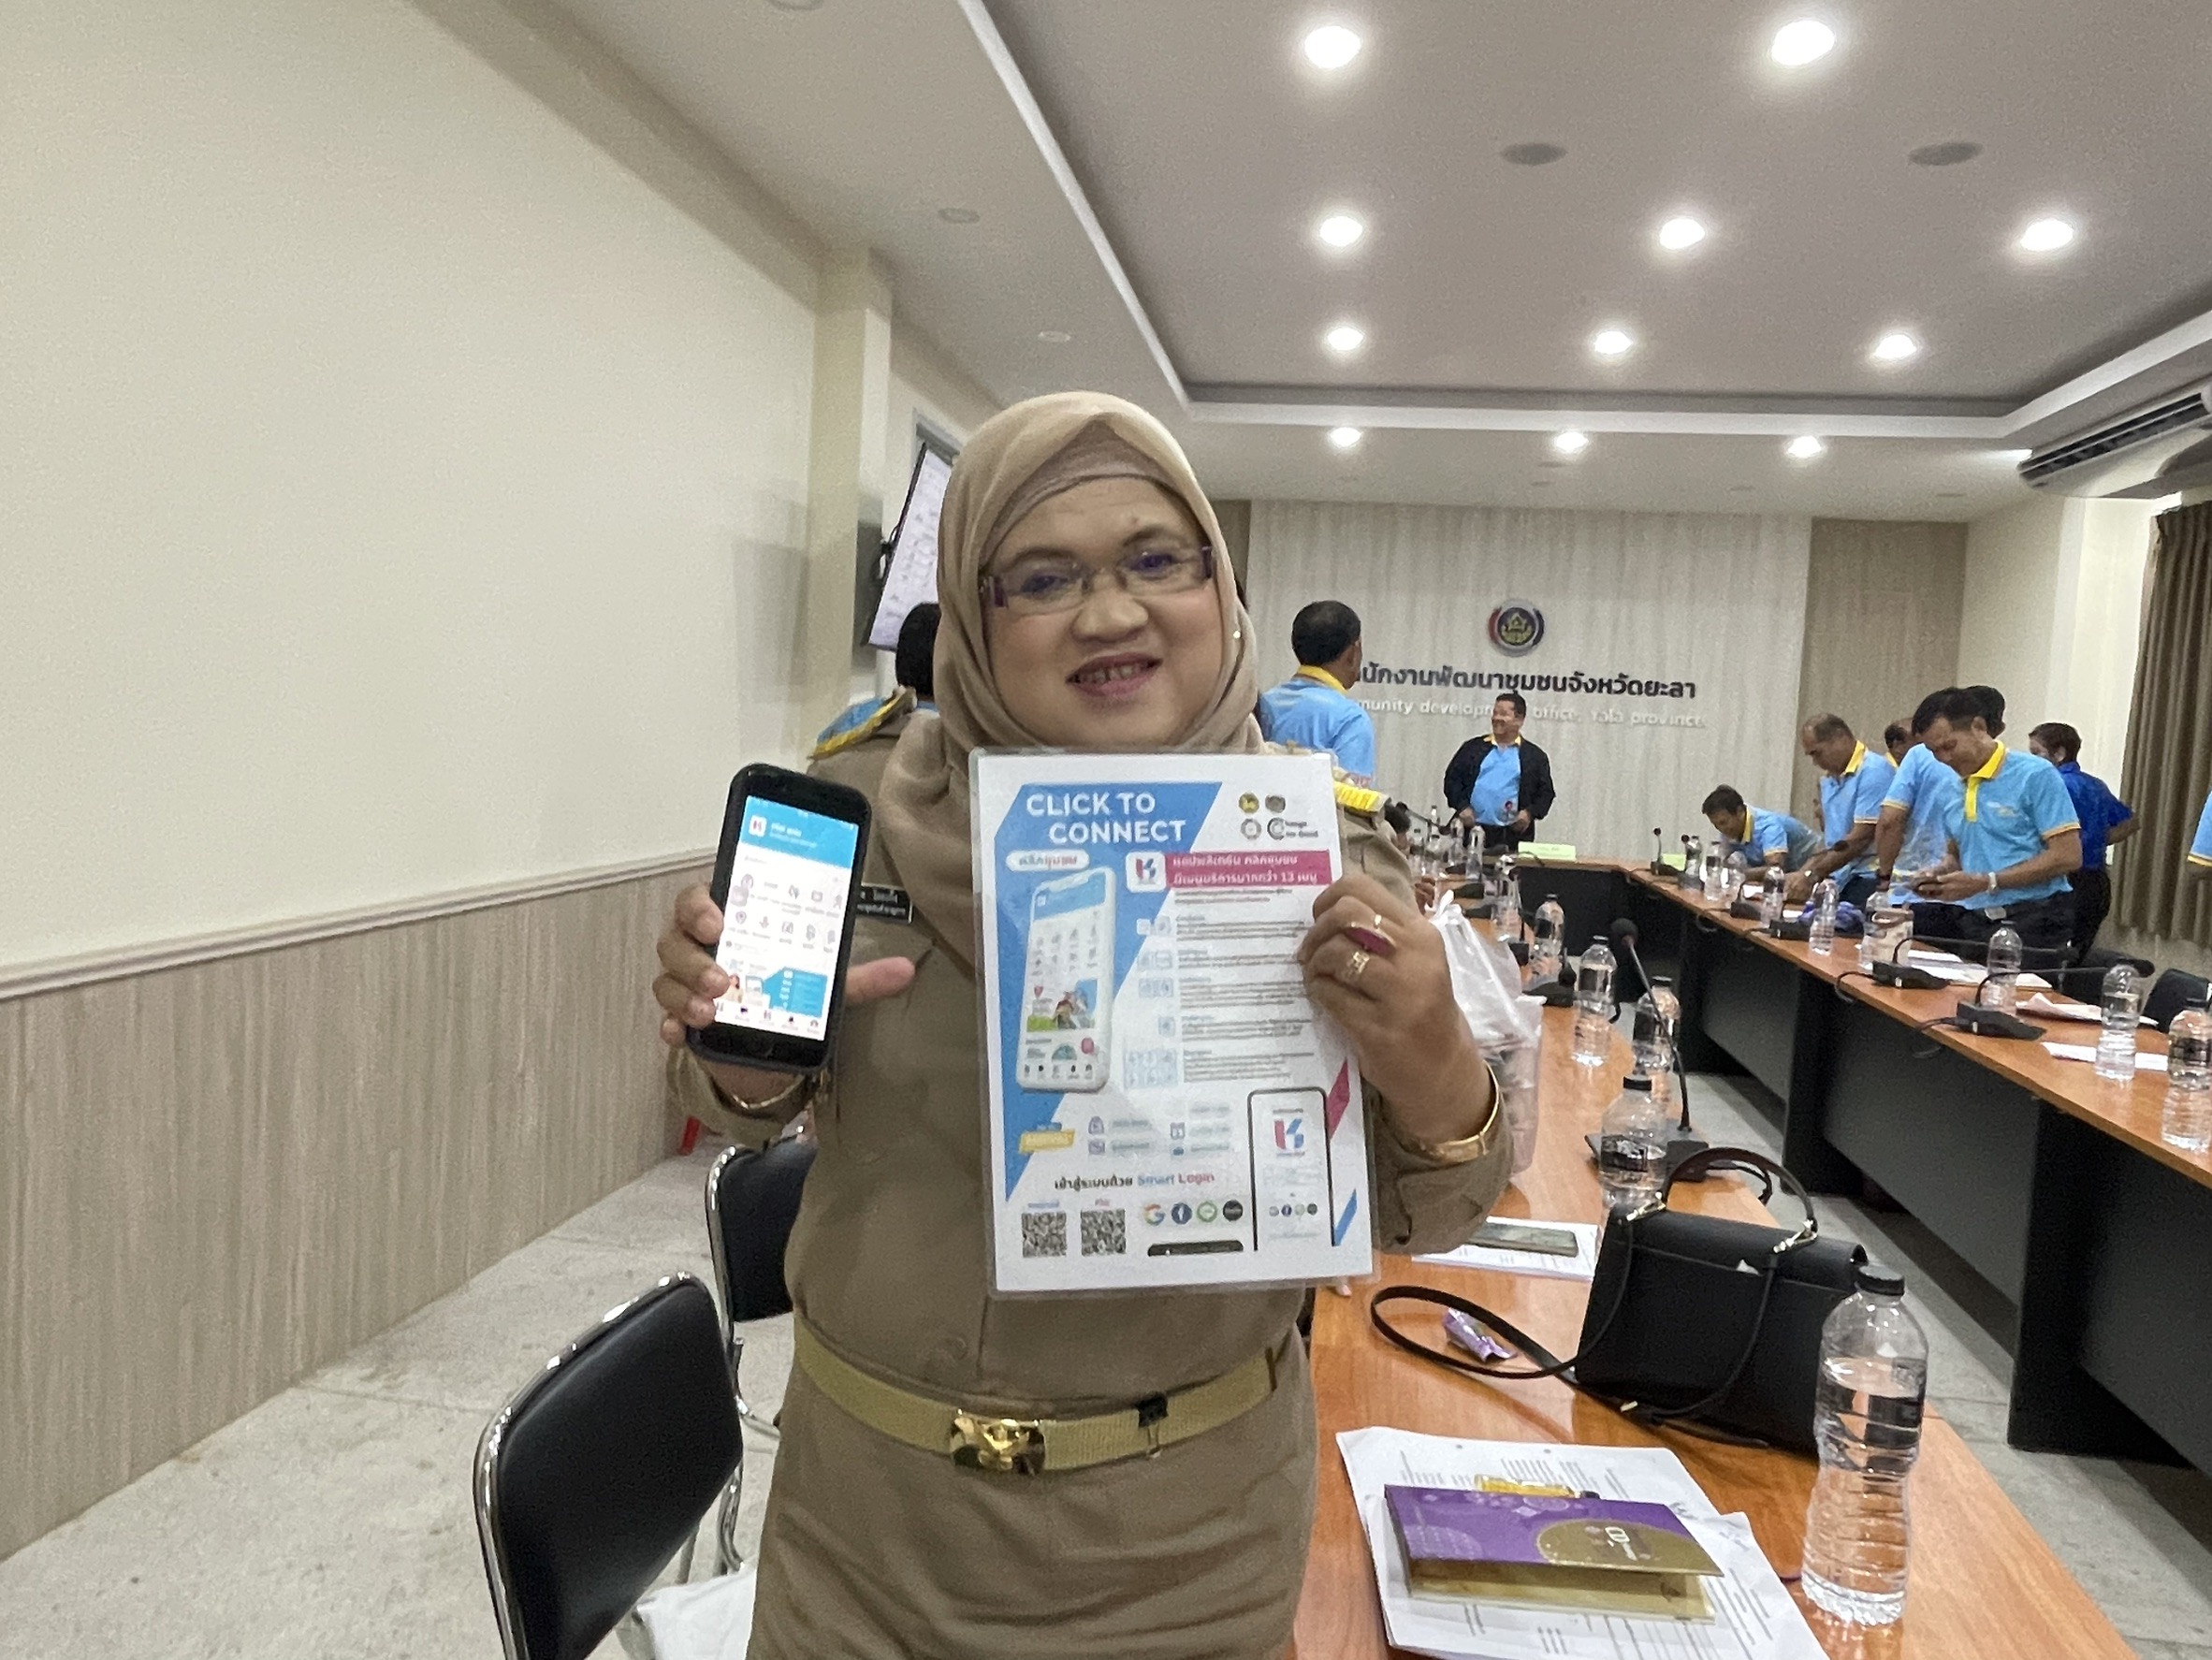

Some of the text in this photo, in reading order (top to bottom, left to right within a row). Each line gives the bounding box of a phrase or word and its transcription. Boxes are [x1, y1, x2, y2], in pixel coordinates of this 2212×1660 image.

[1362, 661, 1695, 699] นักงานพัฒนาชุมชนจังหวัดยะลา
[1026, 792, 1156, 817] CLICK TO
[1048, 820, 1186, 844] CONNECT
[1138, 1173, 1174, 1187] Smart
[1178, 1172, 1215, 1186] Login
